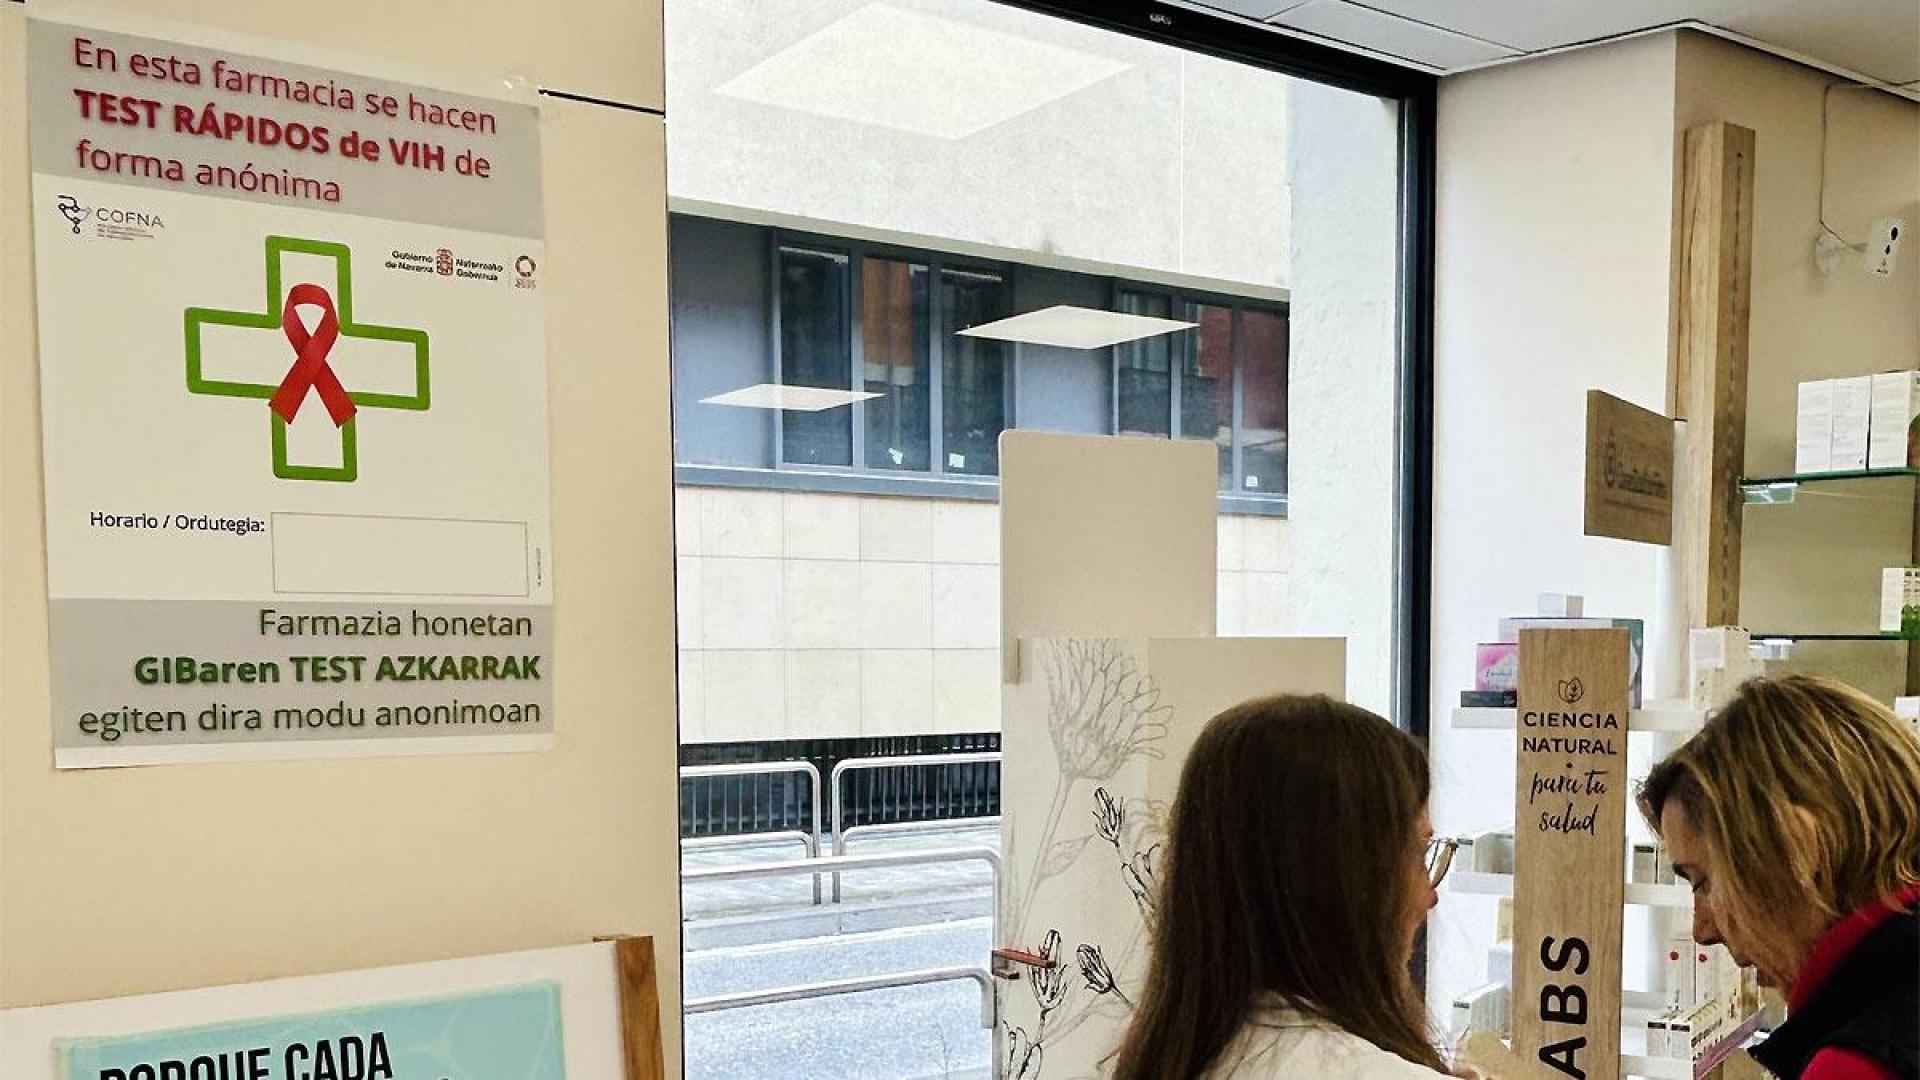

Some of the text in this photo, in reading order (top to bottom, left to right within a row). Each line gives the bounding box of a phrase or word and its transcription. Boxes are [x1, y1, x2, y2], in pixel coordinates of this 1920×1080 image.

[74, 38, 496, 134] En esta farmacia se hacen
[73, 89, 491, 178] TEST RÁPIDOS de VIH de
[77, 139, 341, 202] forma anónima
[96, 208, 165, 228] COFNA
[90, 512, 266, 536] Horario / Ordutegia:
[259, 609, 533, 637] Farmazia honetan
[134, 655, 541, 684] GIBaren TEST AZKARRAK
[79, 699, 541, 742] egiten dira modu anonimoan
[1523, 711, 1618, 729] CIENCIA
[1522, 737, 1617, 755] NATURAL
[1530, 769, 1608, 805] para tu
[1539, 802, 1598, 836] salud
[284, 1031, 393, 1080] CADA
